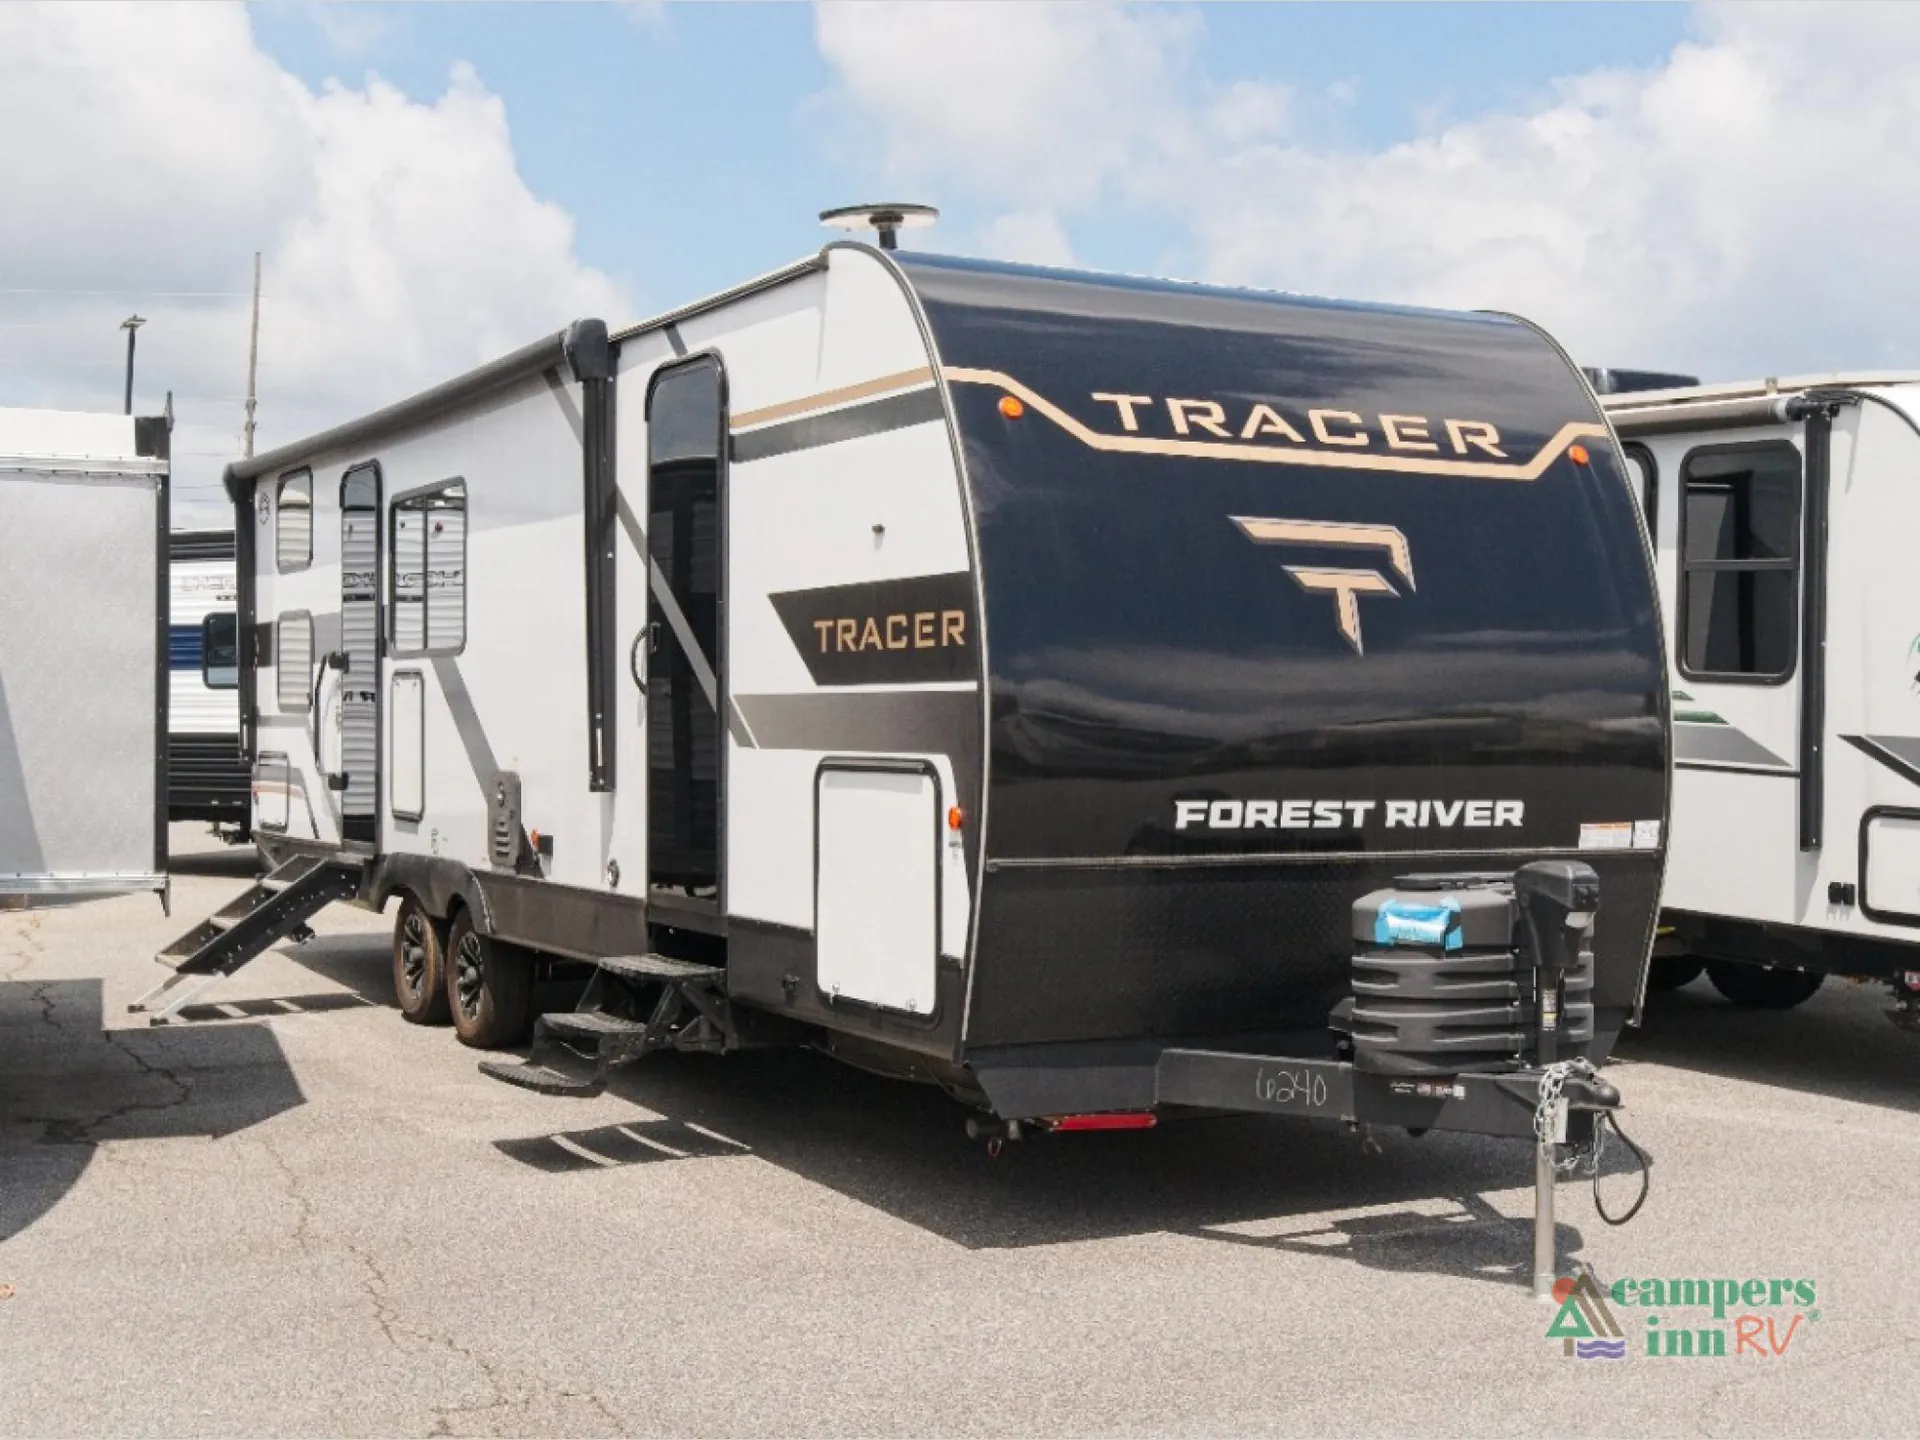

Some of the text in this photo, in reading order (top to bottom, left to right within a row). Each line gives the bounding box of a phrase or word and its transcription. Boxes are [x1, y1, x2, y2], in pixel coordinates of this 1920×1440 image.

[1091, 392, 1508, 457] TRACER
[813, 609, 966, 653] TRACER
[1175, 799, 1525, 829] FOREST RIVER
[1255, 1067, 1327, 1107] 6240
